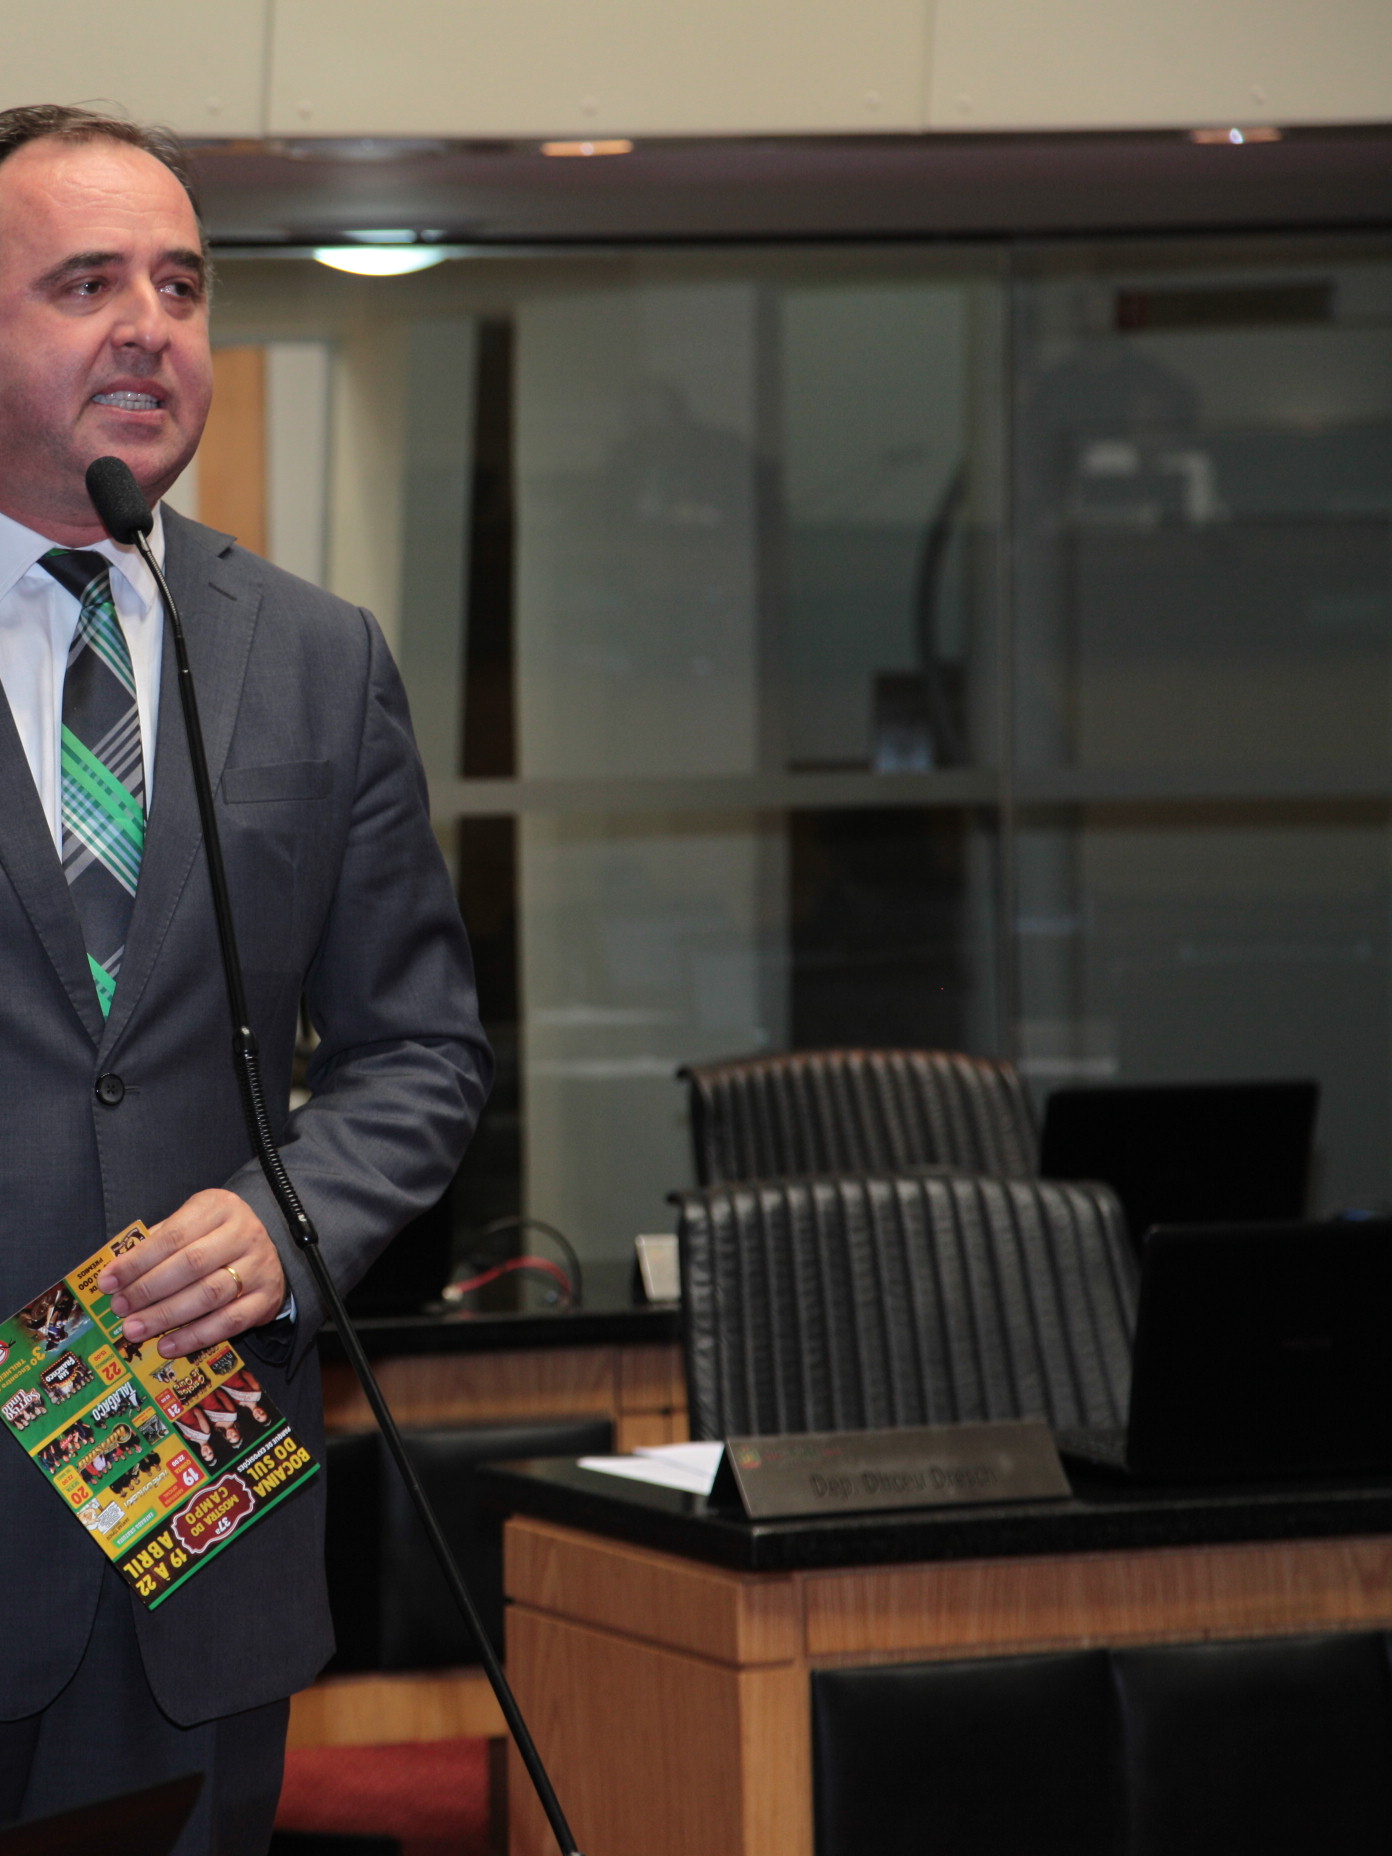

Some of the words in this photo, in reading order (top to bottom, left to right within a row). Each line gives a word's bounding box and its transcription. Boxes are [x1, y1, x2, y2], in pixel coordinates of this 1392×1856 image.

[0, 1363, 31, 1389] Encontro
[56, 1368, 69, 1380] SAN
[100, 1360, 122, 1382] 22
[166, 1402, 181, 1418] 21
[264, 1440, 273, 1450] DE
[270, 1425, 292, 1444] PARQUE
[235, 1444, 267, 1474] EXPOSIÇÕES
[271, 1435, 297, 1461] DO
[179, 1465, 201, 1488] 19
[245, 1453, 276, 1483] SUL
[251, 1445, 311, 1500] BOCAINA
[69, 1485, 90, 1506] 20
[183, 1484, 229, 1526] CAMPO
[202, 1493, 239, 1526] MOSTRA
[189, 1521, 205, 1538] DO
[121, 1530, 177, 1581] ABRIL
[166, 1546, 189, 1569] 19
[134, 1573, 158, 1598] 22
